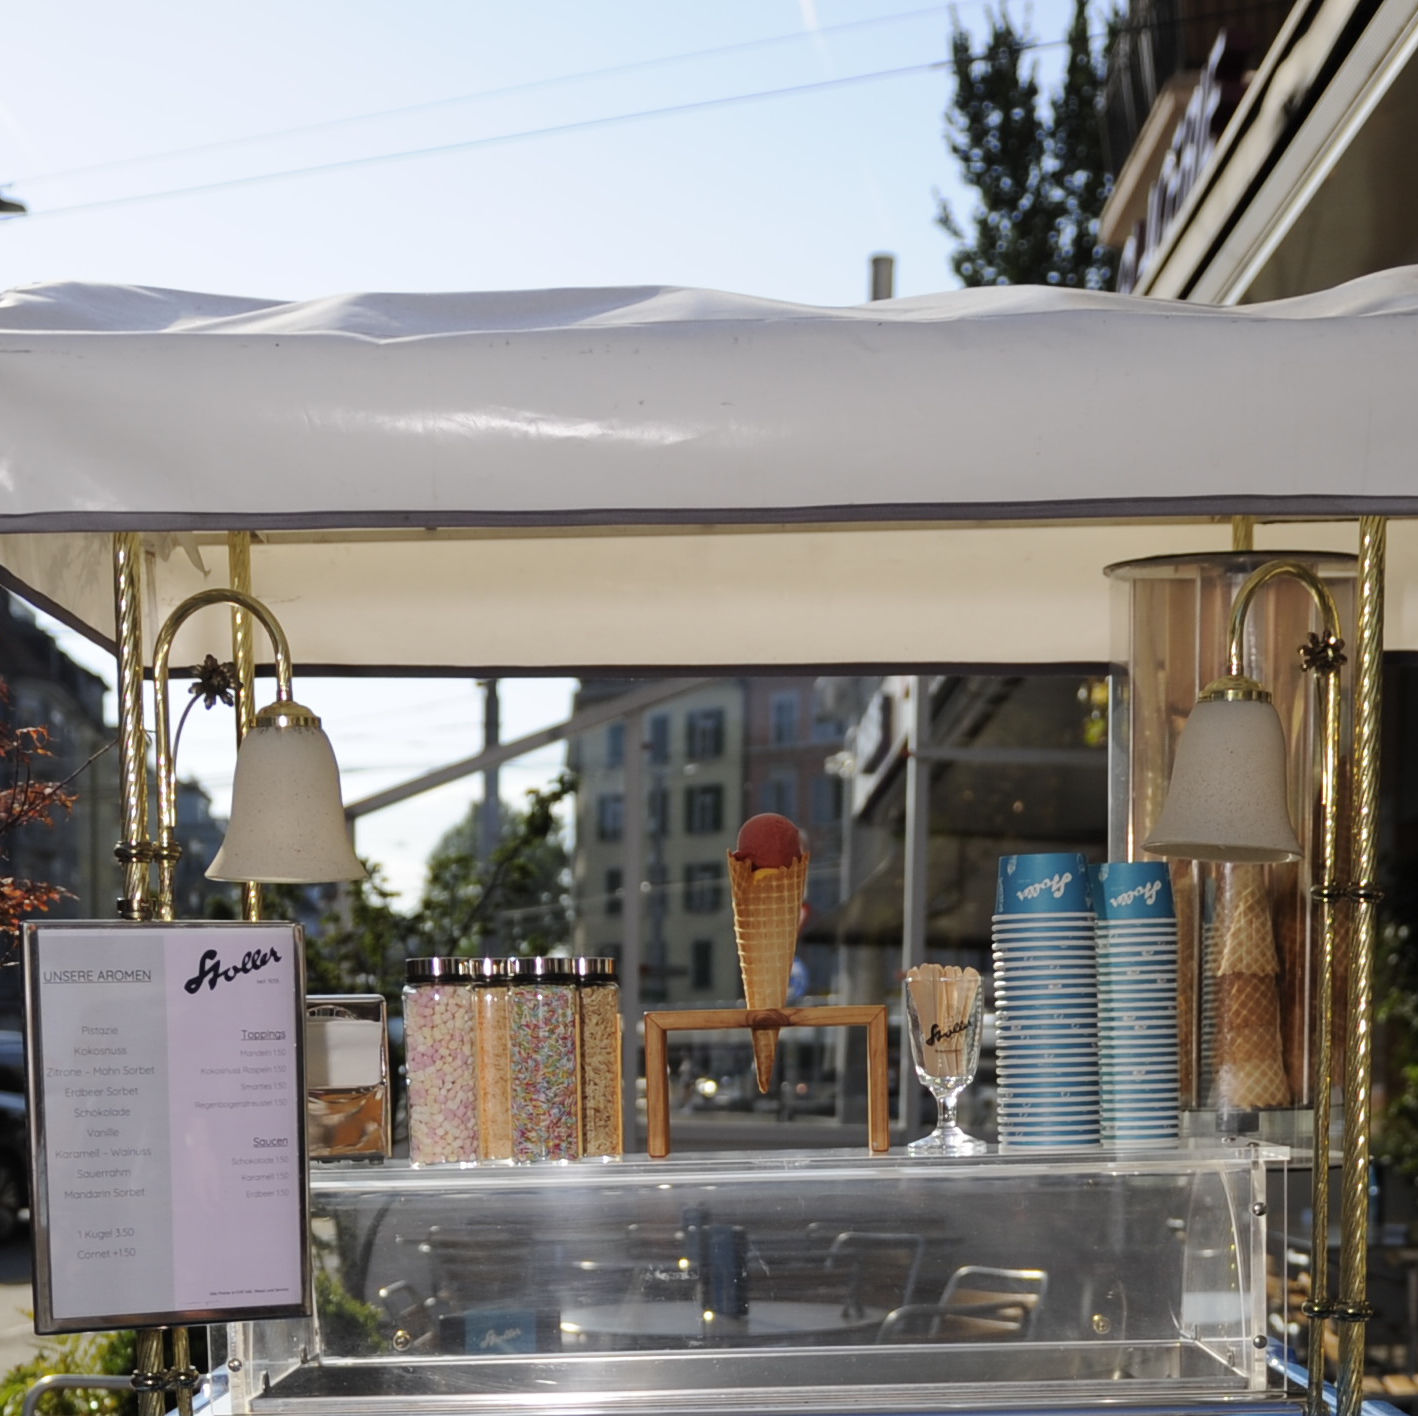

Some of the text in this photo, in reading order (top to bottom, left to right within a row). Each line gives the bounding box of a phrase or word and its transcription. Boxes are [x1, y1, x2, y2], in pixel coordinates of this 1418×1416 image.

[184, 946, 282, 994] Stoller
[43, 969, 152, 983] UNSERE AROMEN
[81, 1026, 118, 1035] Pistazie
[241, 1029, 286, 1041] Toppings
[73, 1047, 127, 1056] Kokosnuss
[46, 1067, 82, 1077] Zitrone
[93, 1066, 121, 1076] Mohn
[123, 1065, 155, 1075] Sorbet
[64, 1086, 138, 1097] Erdbeer Sorbet
[73, 1107, 131, 1118] Schokolade
[86, 1128, 119, 1138] Vanille
[252, 1136, 289, 1148] Saucen
[55, 1148, 100, 1159] Karamell
[110, 1147, 152, 1157] Walnuss
[76, 1168, 131, 1179] Sauerrahm
[64, 1188, 145, 1200] Mandarin Sorbet
[84, 1229, 113, 1240] Kugel
[76, 1249, 110, 1260] Cornet
